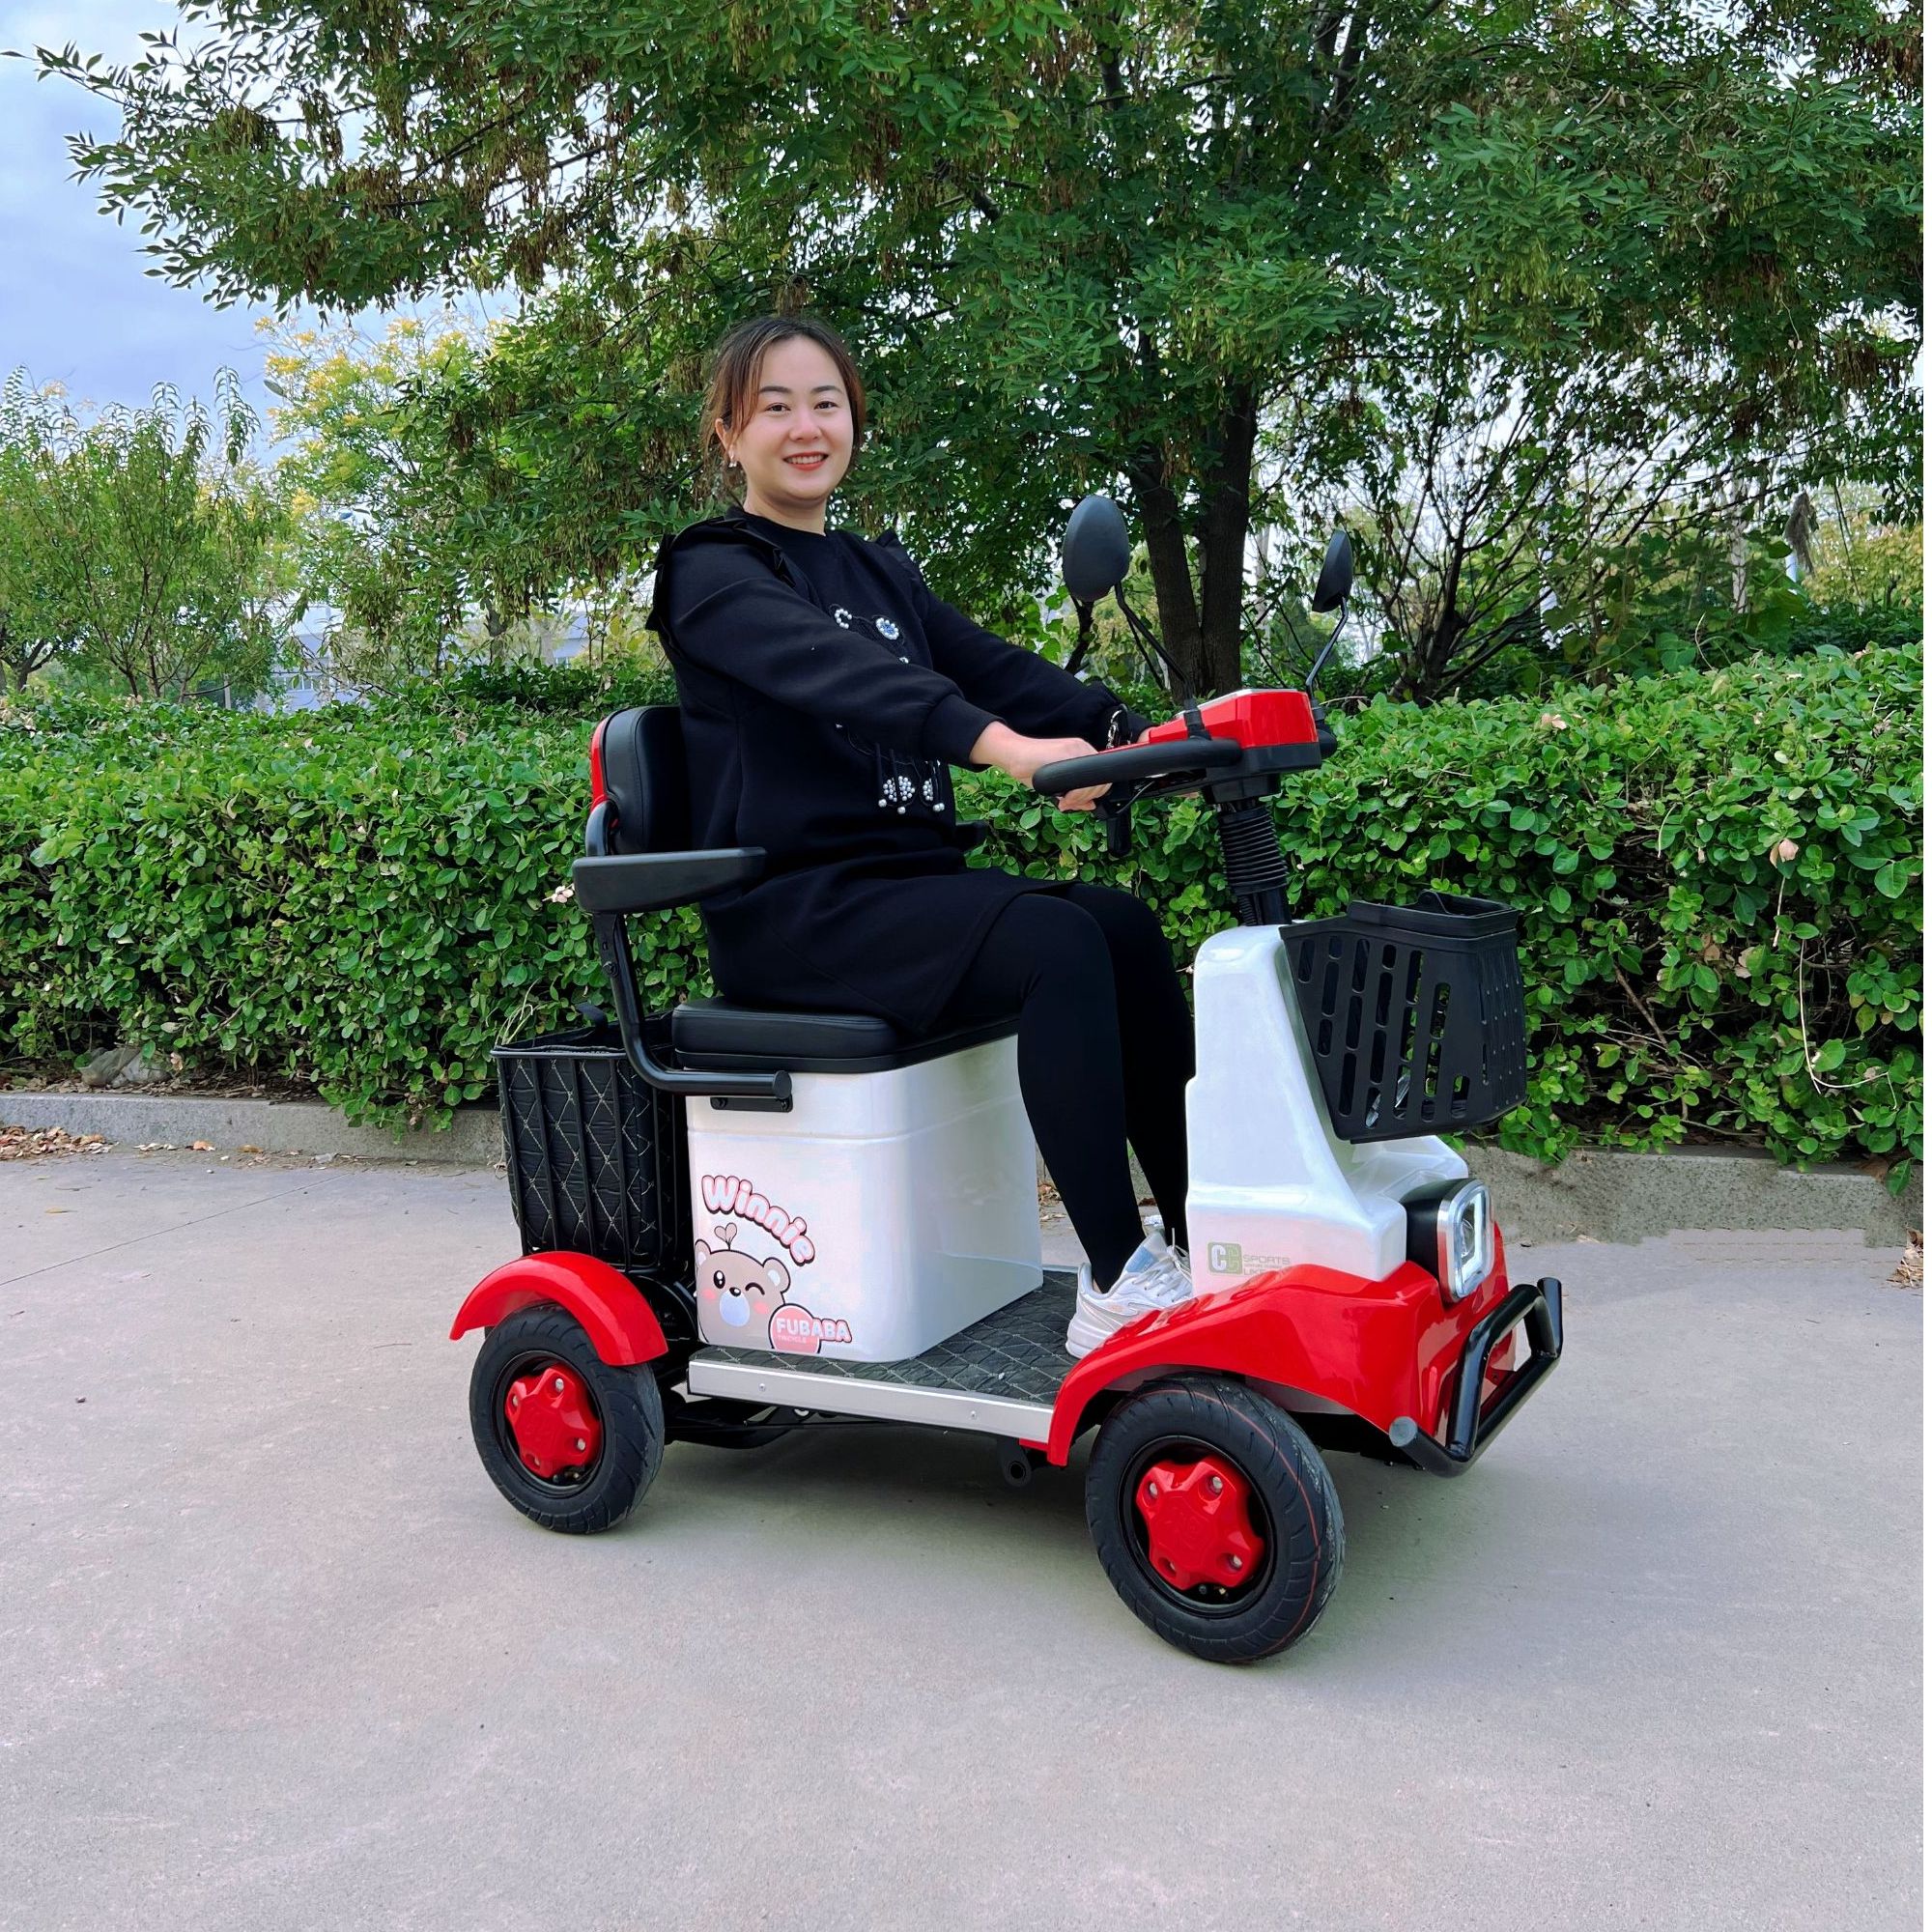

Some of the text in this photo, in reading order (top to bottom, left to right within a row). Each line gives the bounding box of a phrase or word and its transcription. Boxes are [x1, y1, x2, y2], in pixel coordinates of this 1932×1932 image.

[701, 1175, 815, 1266] Winnie
[1242, 1254, 1291, 1265] SPORTS
[776, 1318, 852, 1343] FUBABA
